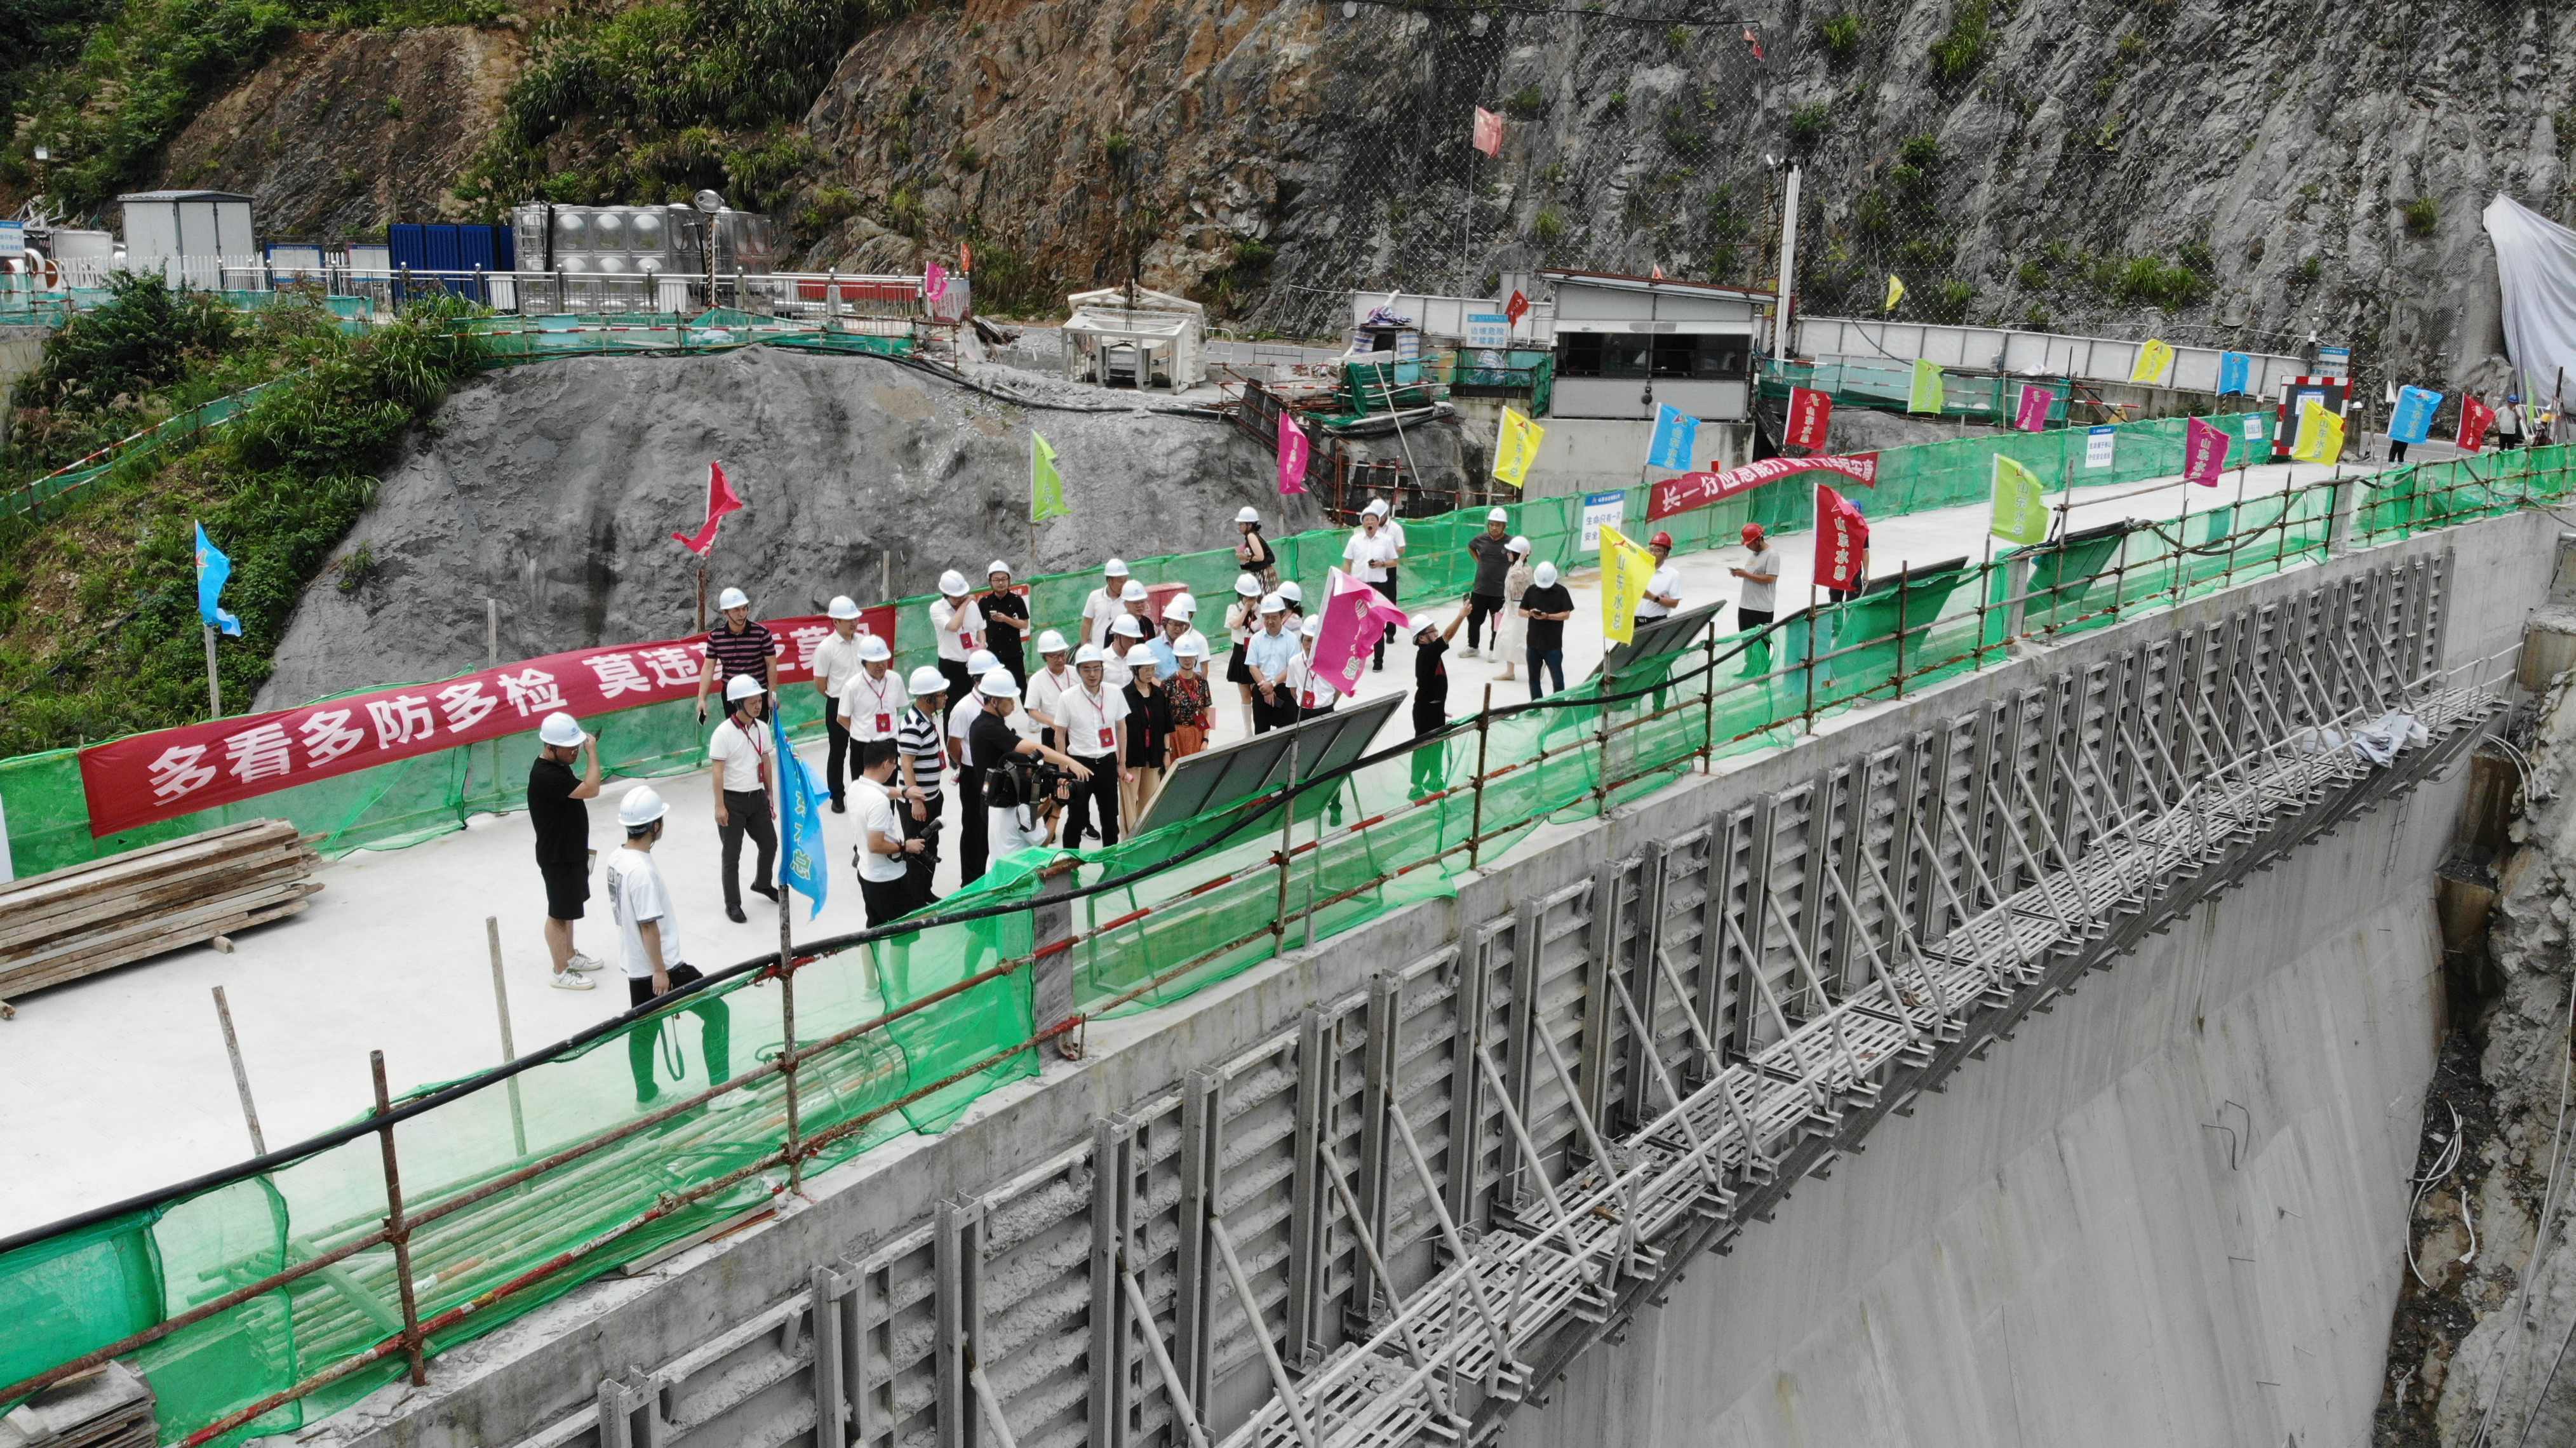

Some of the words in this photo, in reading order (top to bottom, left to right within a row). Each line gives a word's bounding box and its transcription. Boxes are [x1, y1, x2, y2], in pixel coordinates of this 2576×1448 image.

[1508, 431, 1525, 478] 山东水总
[2312, 419, 2329, 459] 山东水总
[1662, 459, 1789, 513] 长一分应急能力
[2011, 481, 2030, 537] 山东水总
[1585, 511, 1621, 525] 生命只有一次
[1833, 516, 1850, 582] 山东水总
[1612, 554, 1627, 630] 山东水总
[147, 667, 568, 807] 多看多防多检
[582, 622, 870, 699] 莫违莫
